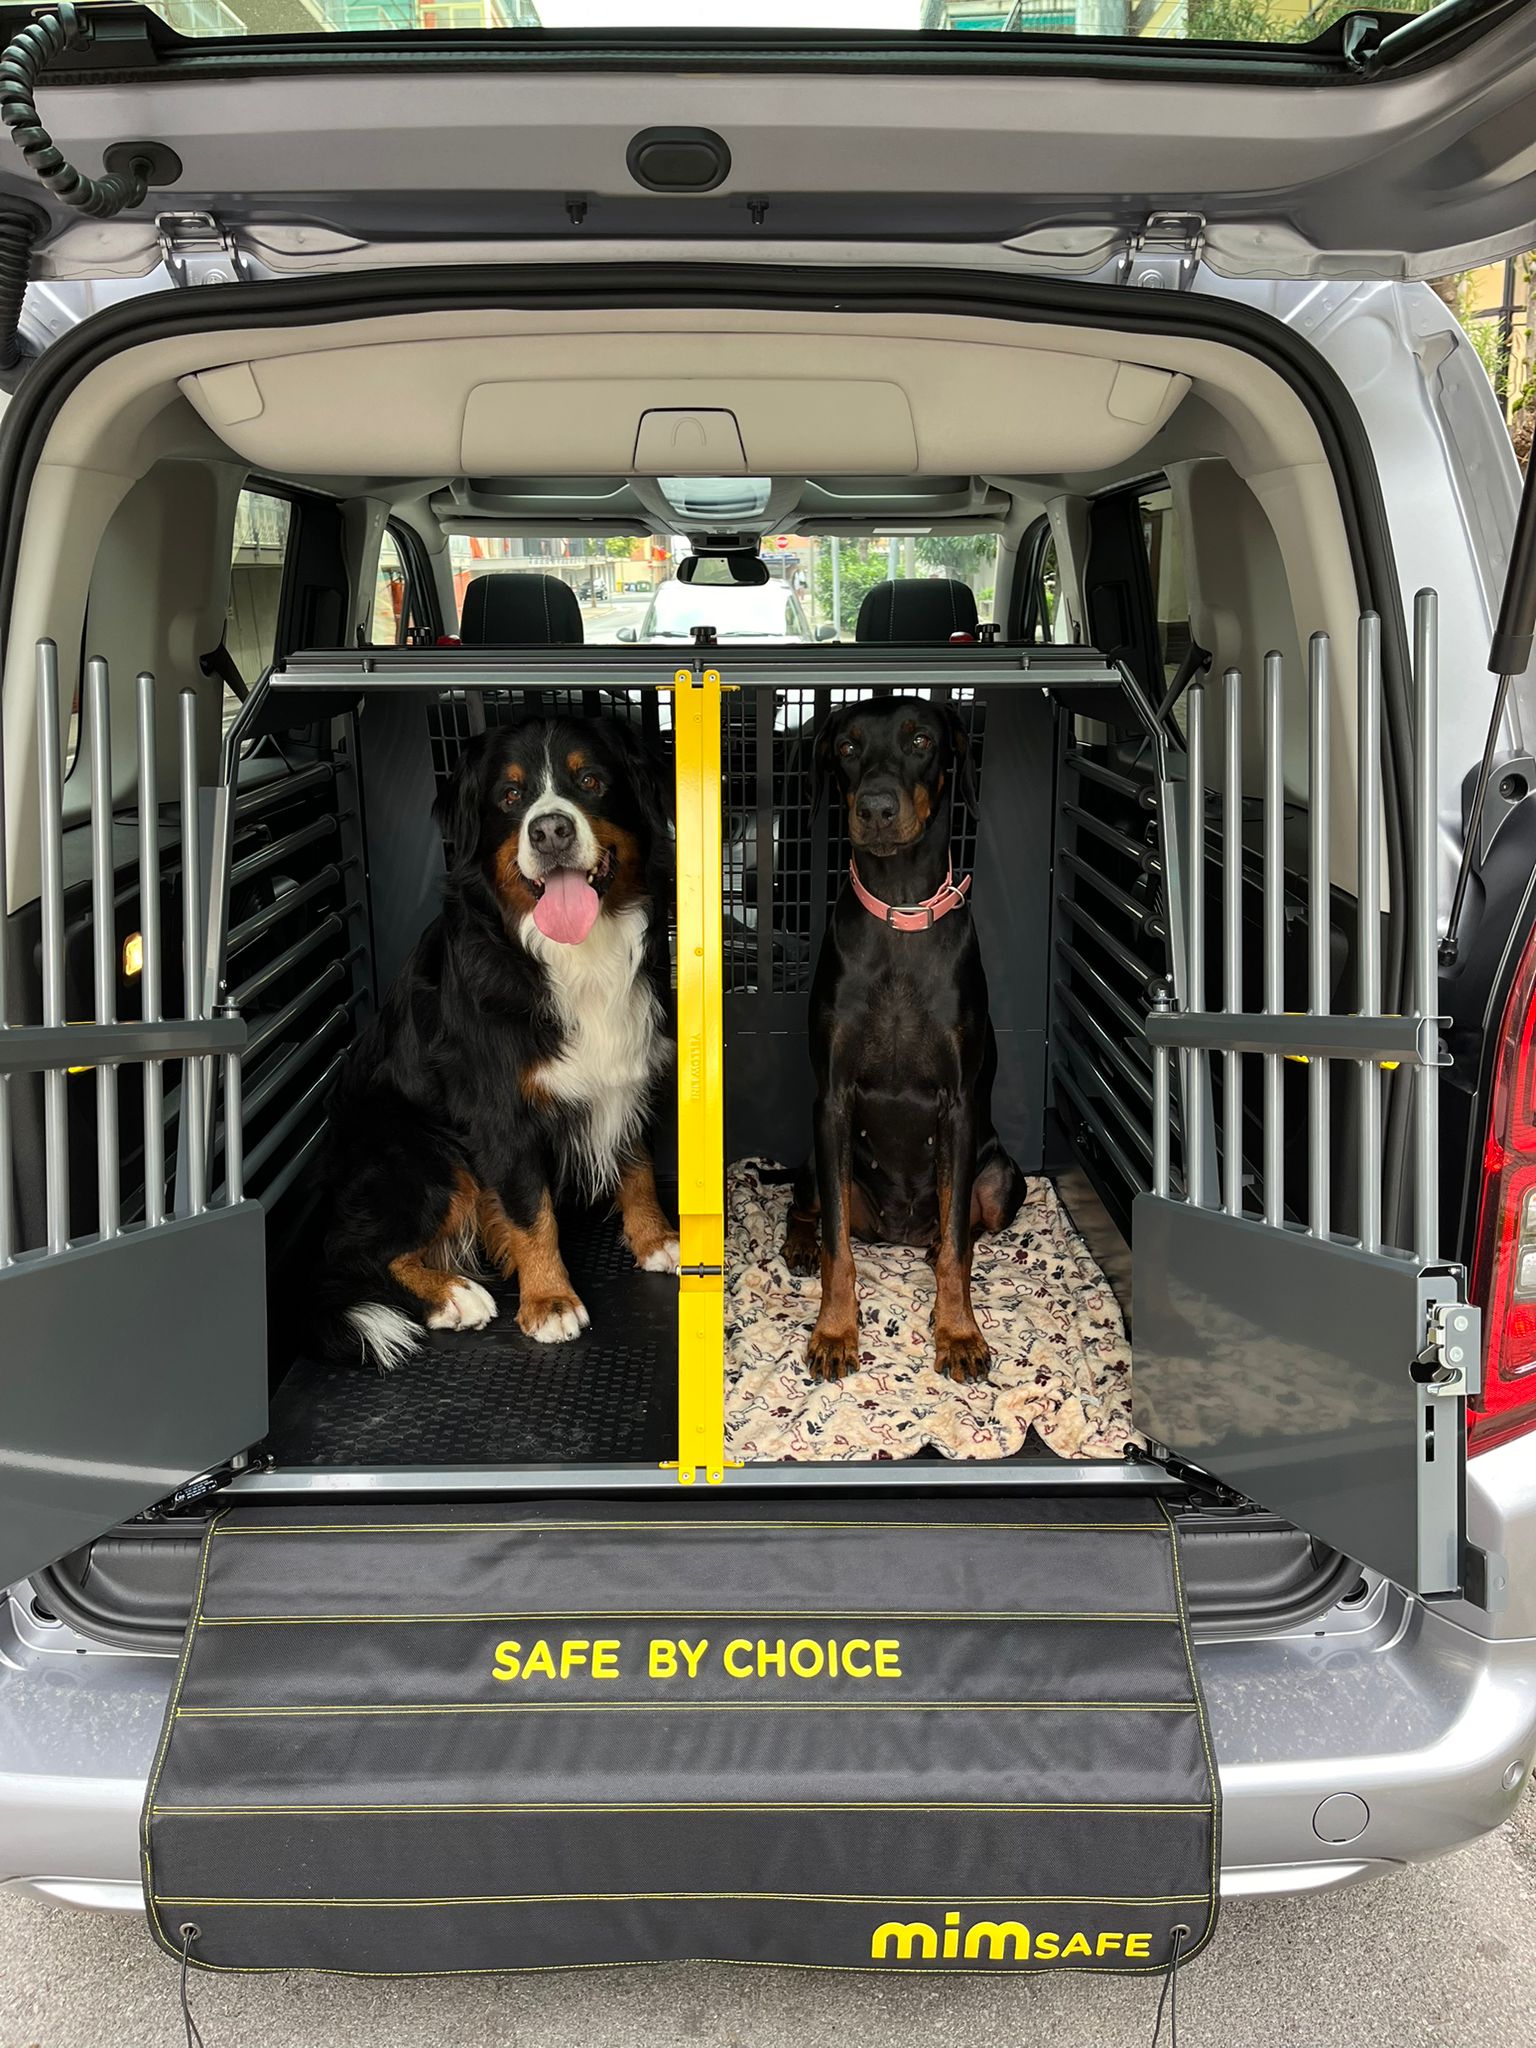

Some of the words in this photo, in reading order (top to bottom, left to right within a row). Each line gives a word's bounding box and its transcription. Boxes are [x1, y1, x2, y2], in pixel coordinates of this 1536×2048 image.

[492, 1640, 621, 1681] SAFE
[648, 1639, 708, 1679] BY
[723, 1639, 902, 1679] CHOICE
